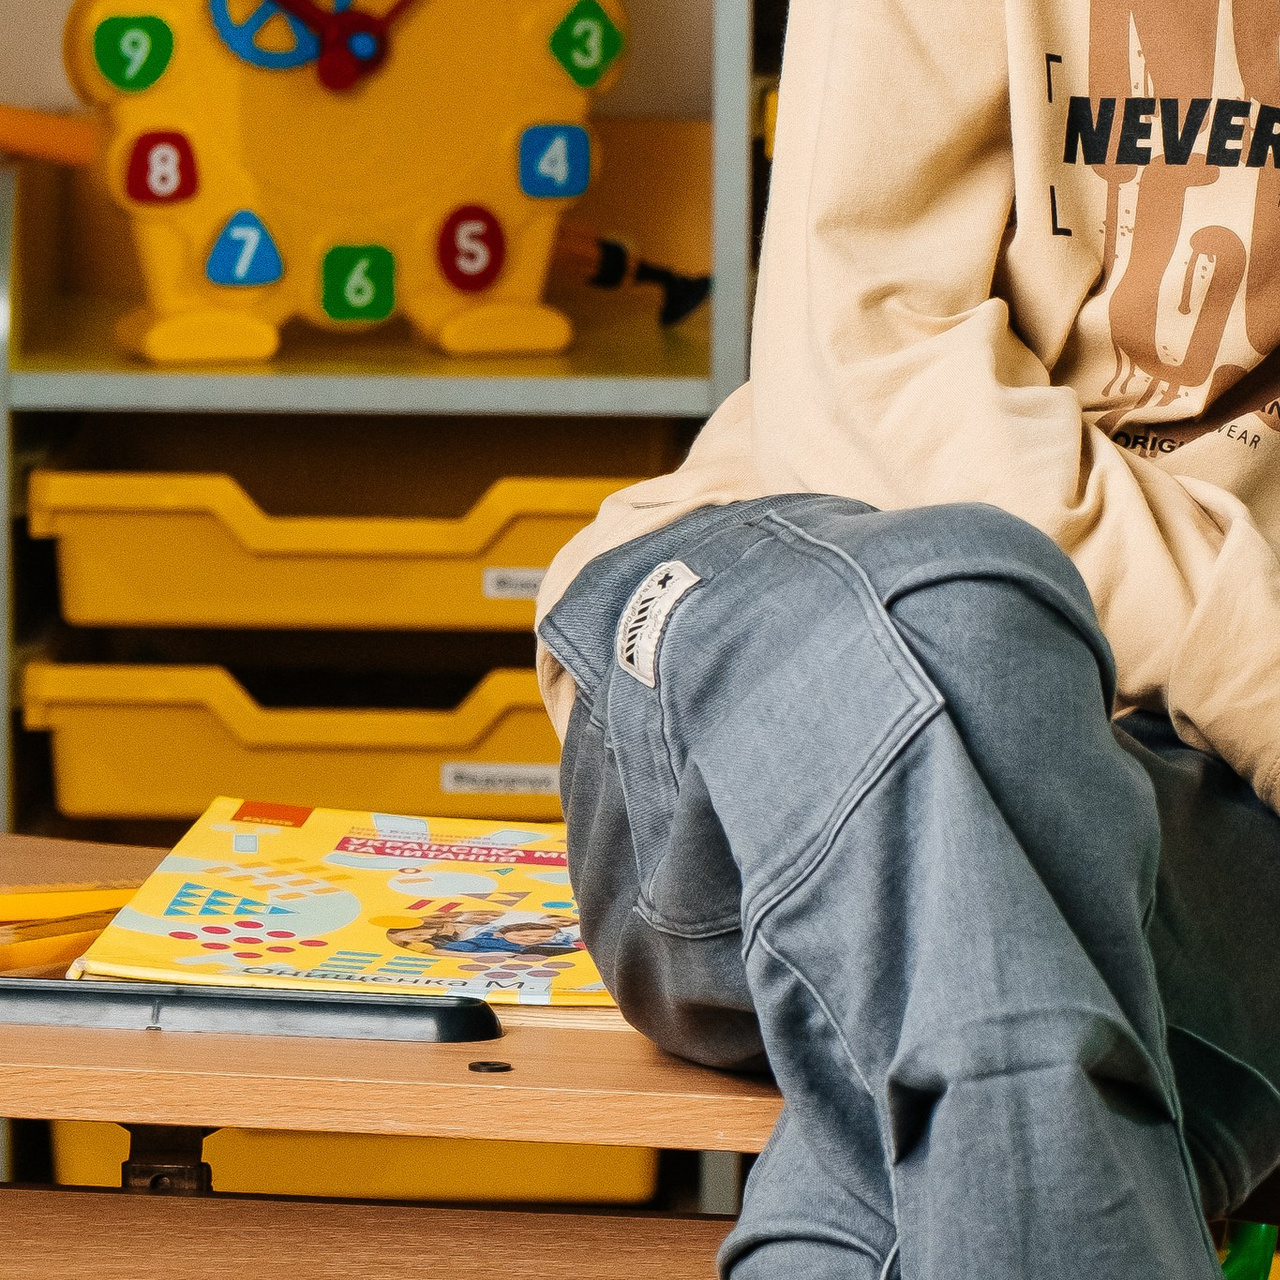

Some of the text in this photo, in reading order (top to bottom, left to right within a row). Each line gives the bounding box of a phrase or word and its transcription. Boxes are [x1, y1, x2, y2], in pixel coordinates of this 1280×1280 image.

[119, 28, 151, 80] 9
[571, 20, 601, 68] 3
[147, 142, 181, 196] 8
[537, 136, 570, 185] 4
[231, 227, 261, 278] 7
[456, 221, 490, 274] 5
[344, 260, 375, 308] 6
[346, 843, 518, 864] ТА ЧИТАННЯ
[348, 837, 526, 858] УКРАЇНСЬКА
